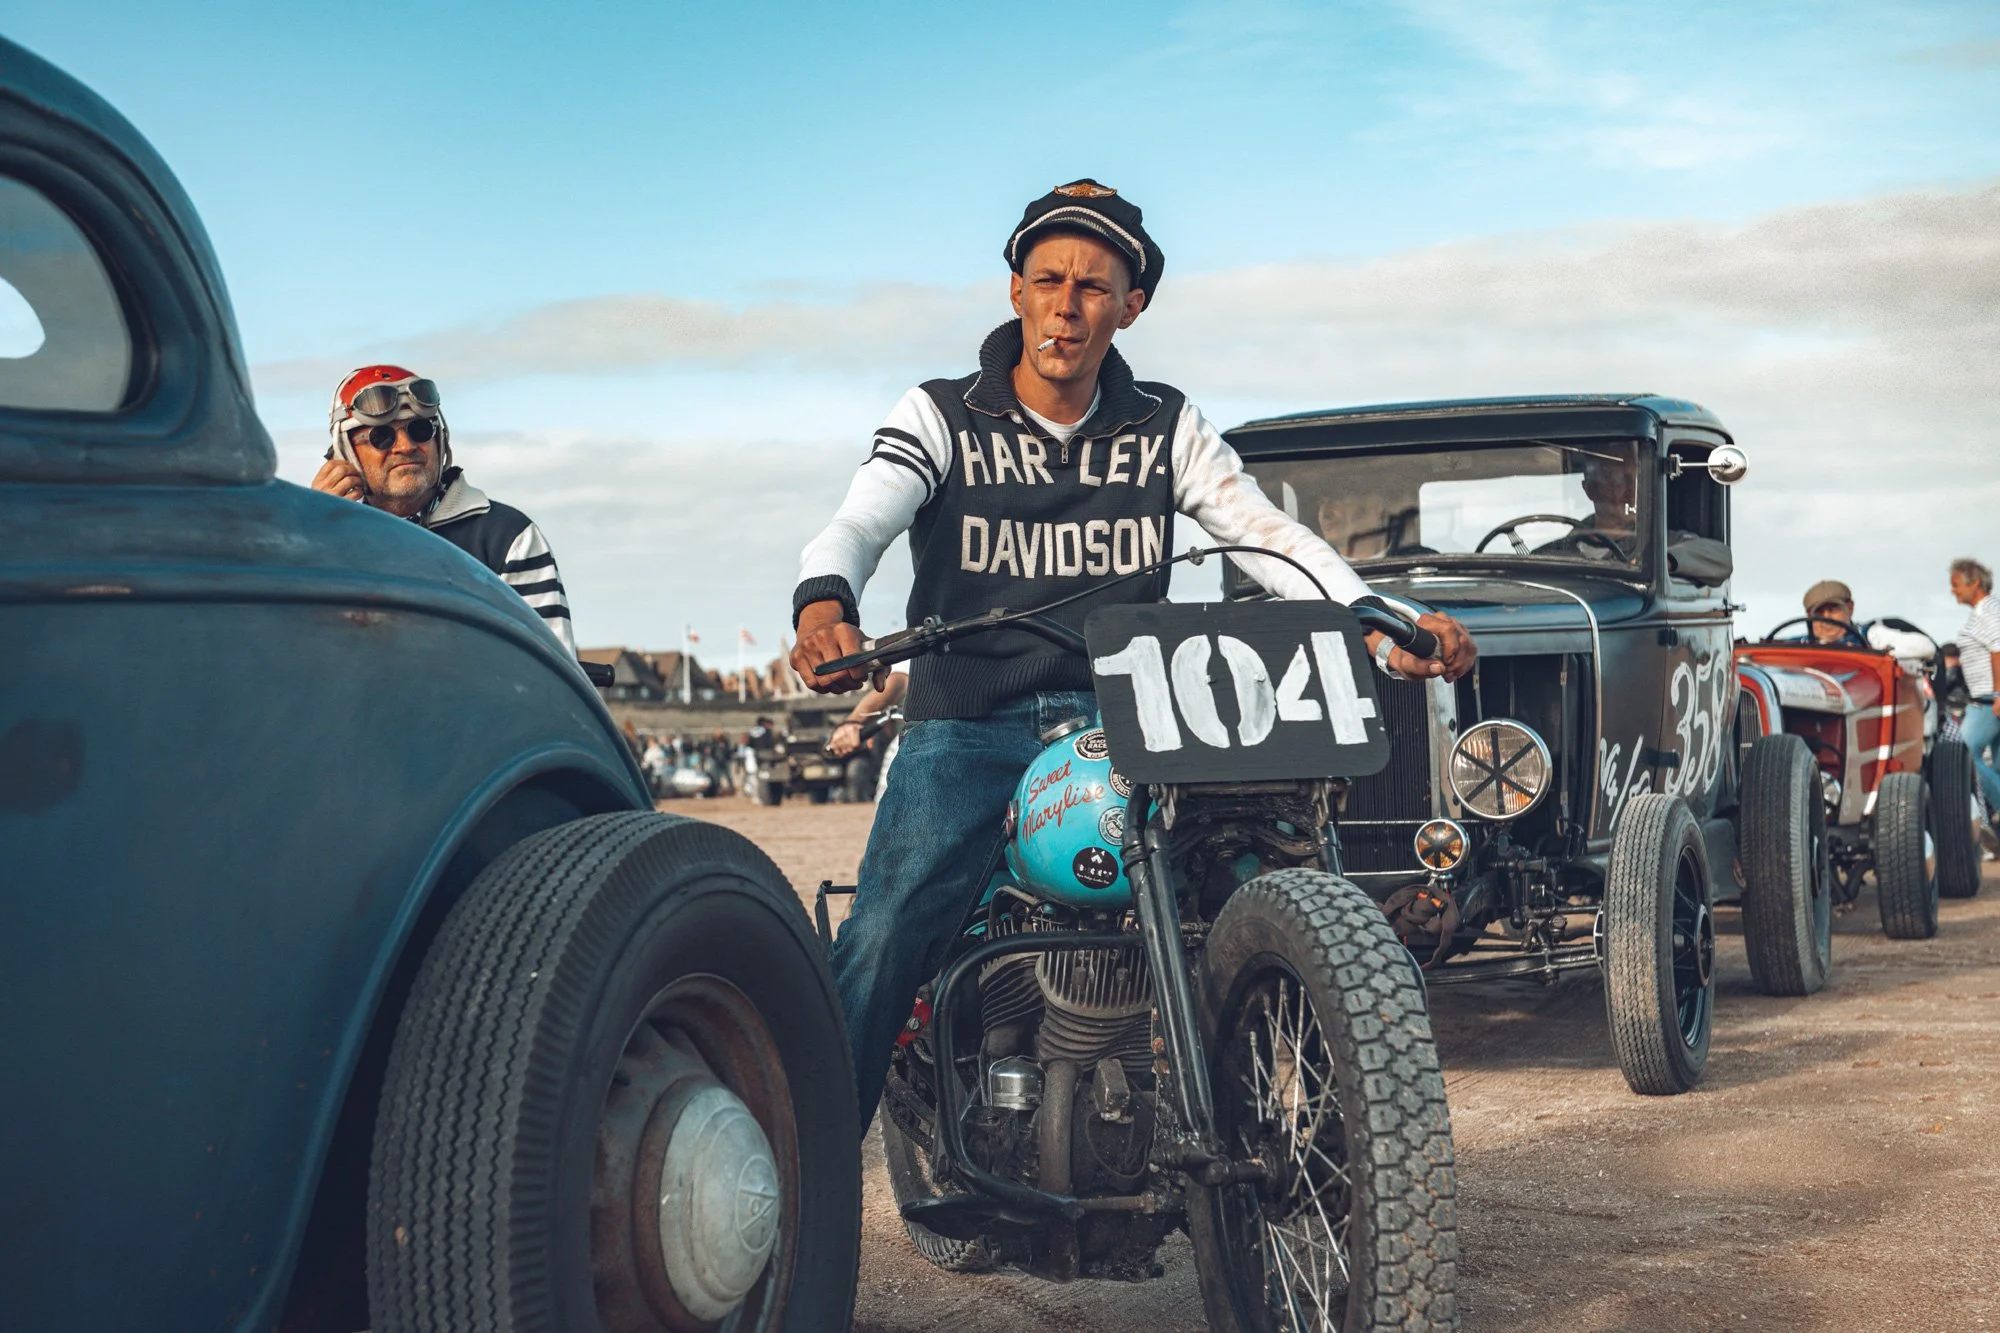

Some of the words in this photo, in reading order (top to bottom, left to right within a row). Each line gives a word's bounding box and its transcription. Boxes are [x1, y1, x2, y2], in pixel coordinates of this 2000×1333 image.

[960, 515, 1166, 578] DAVIDSON
[1094, 631, 1377, 752] 104
[1664, 650, 1727, 797] 358
[1029, 760, 1071, 804] Sweet
[1023, 785, 1105, 844] Marylise
